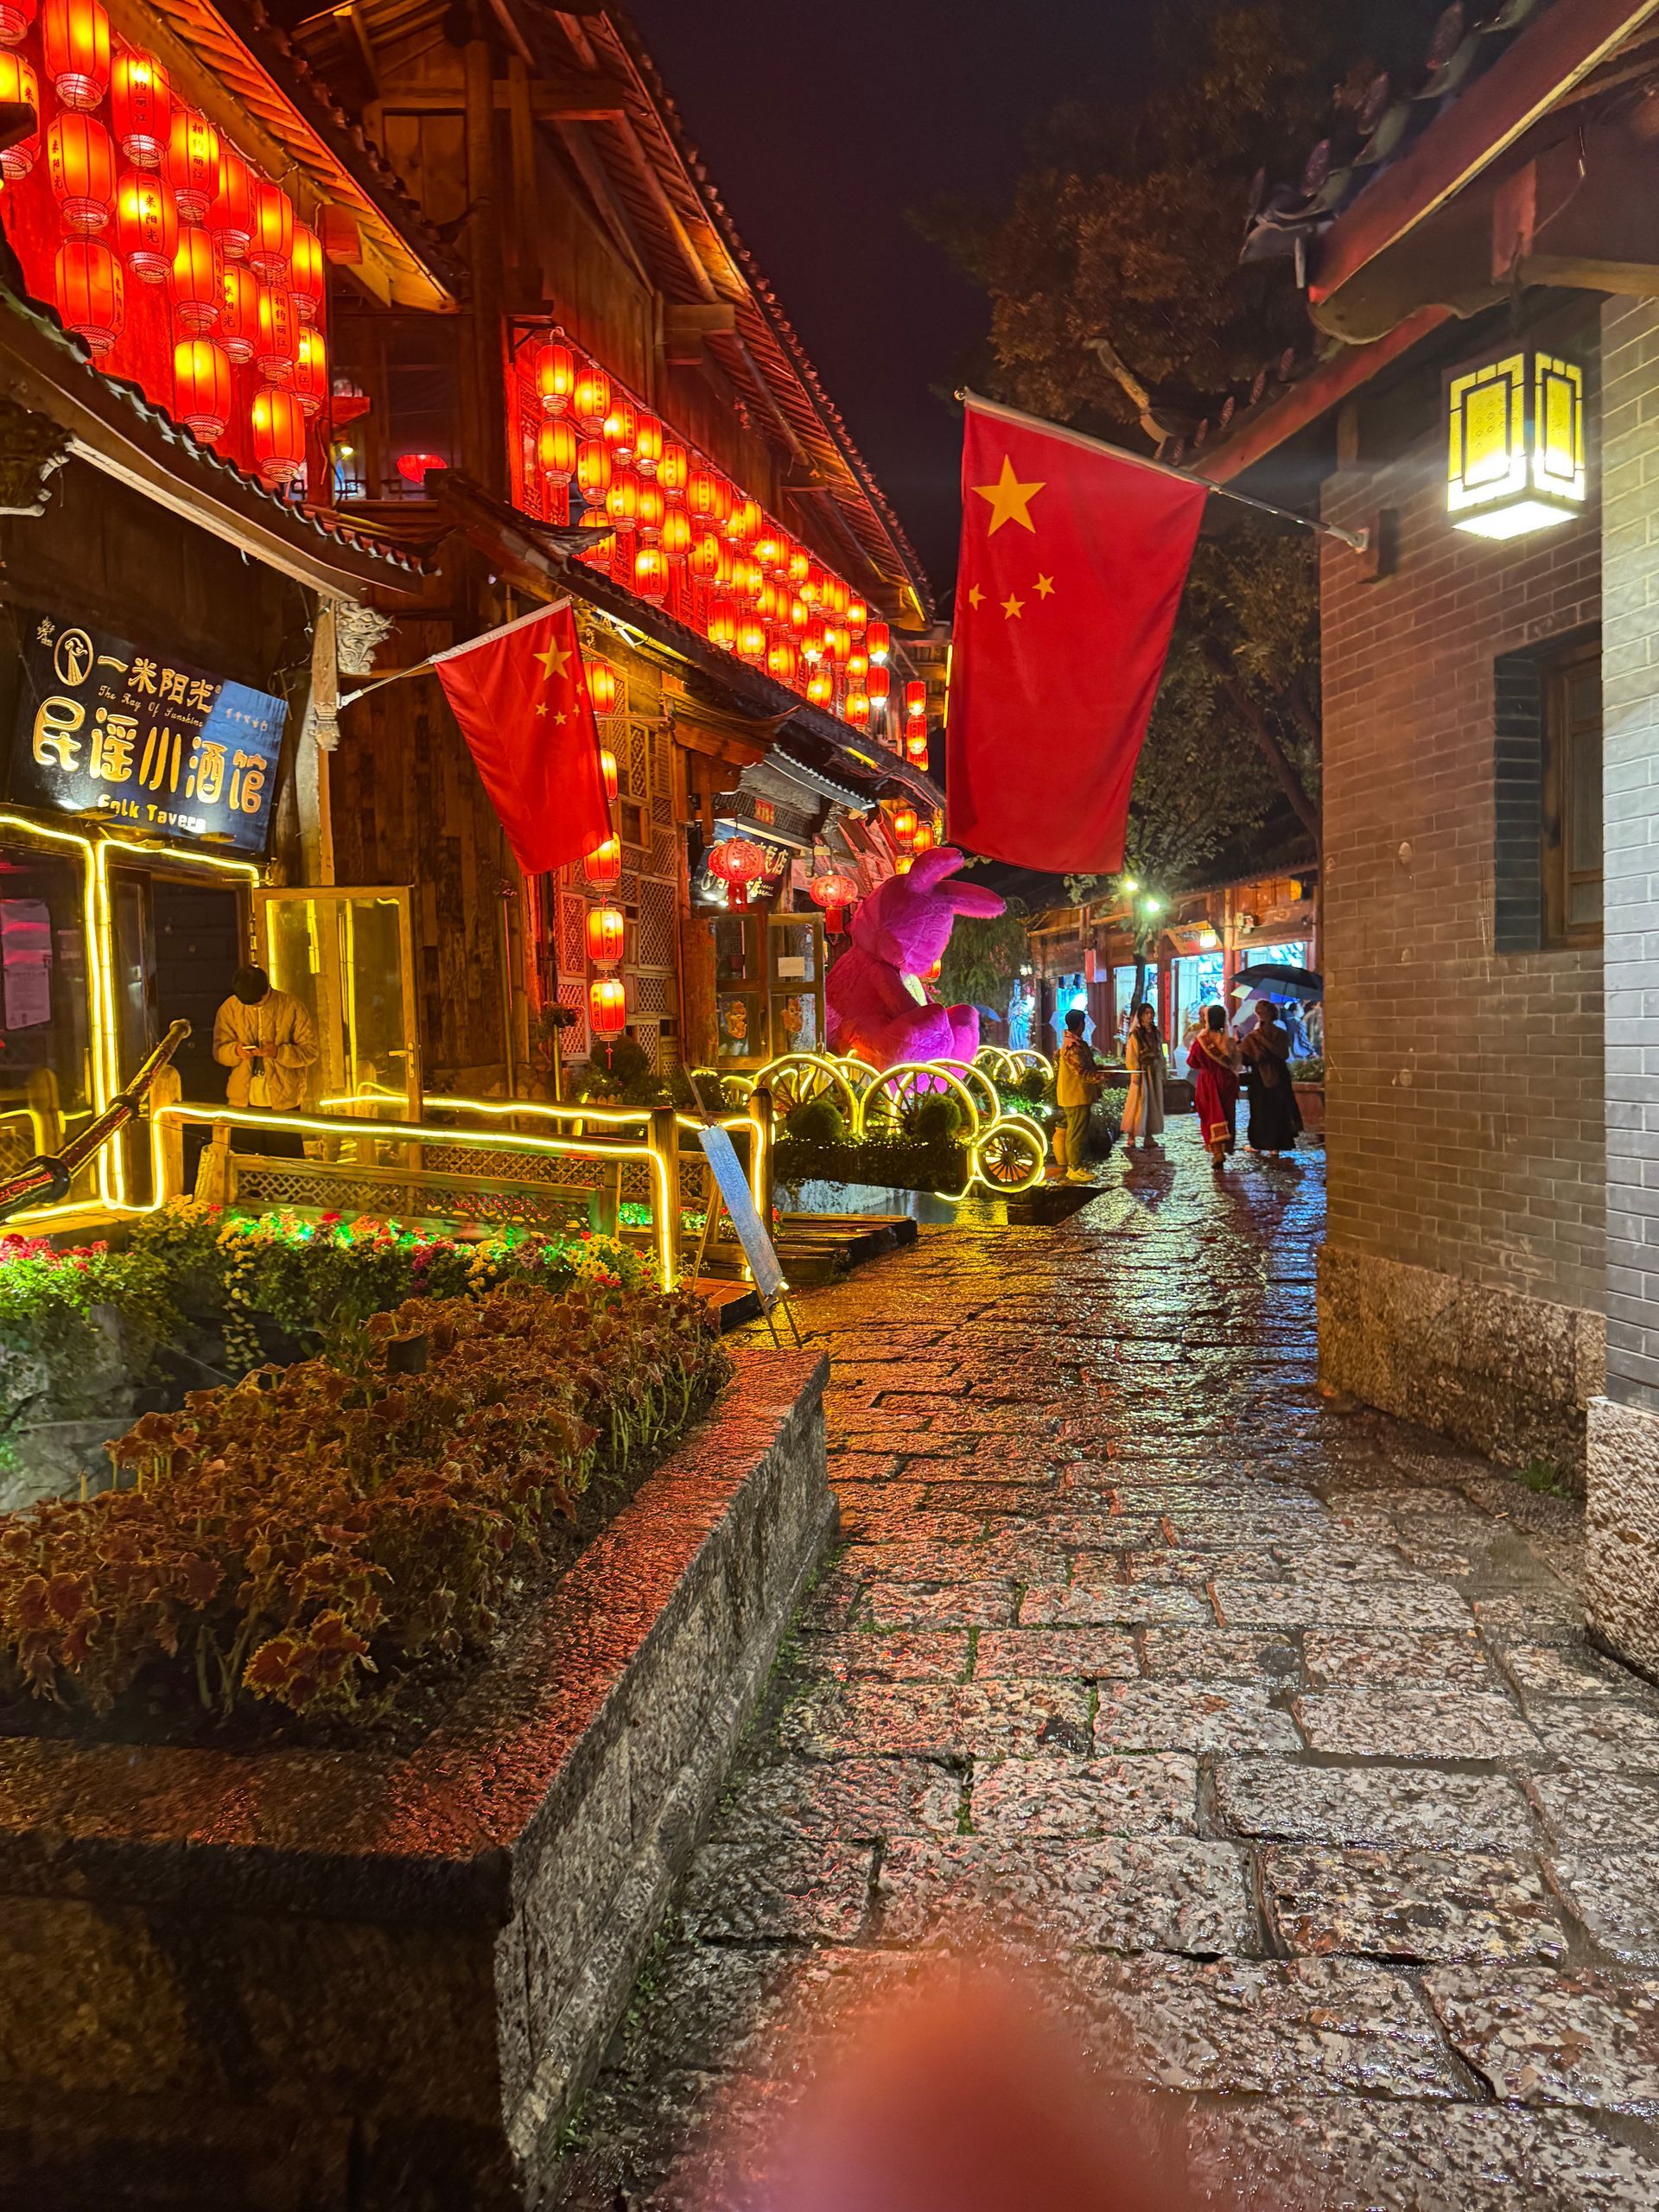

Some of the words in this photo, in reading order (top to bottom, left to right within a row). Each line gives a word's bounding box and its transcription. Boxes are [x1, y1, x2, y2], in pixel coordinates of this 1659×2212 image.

[141, 181, 160, 245] 一米阳光
[275, 295, 288, 347] 相约丽江
[97, 655, 214, 714] 一米阳光
[98, 685, 117, 701] The
[121, 692, 142, 713] Ray
[148, 701, 161, 719] Of
[163, 707, 204, 728] Sunshine
[32, 696, 269, 815] 民谣小酒馆
[146, 804, 207, 834] Tavern
